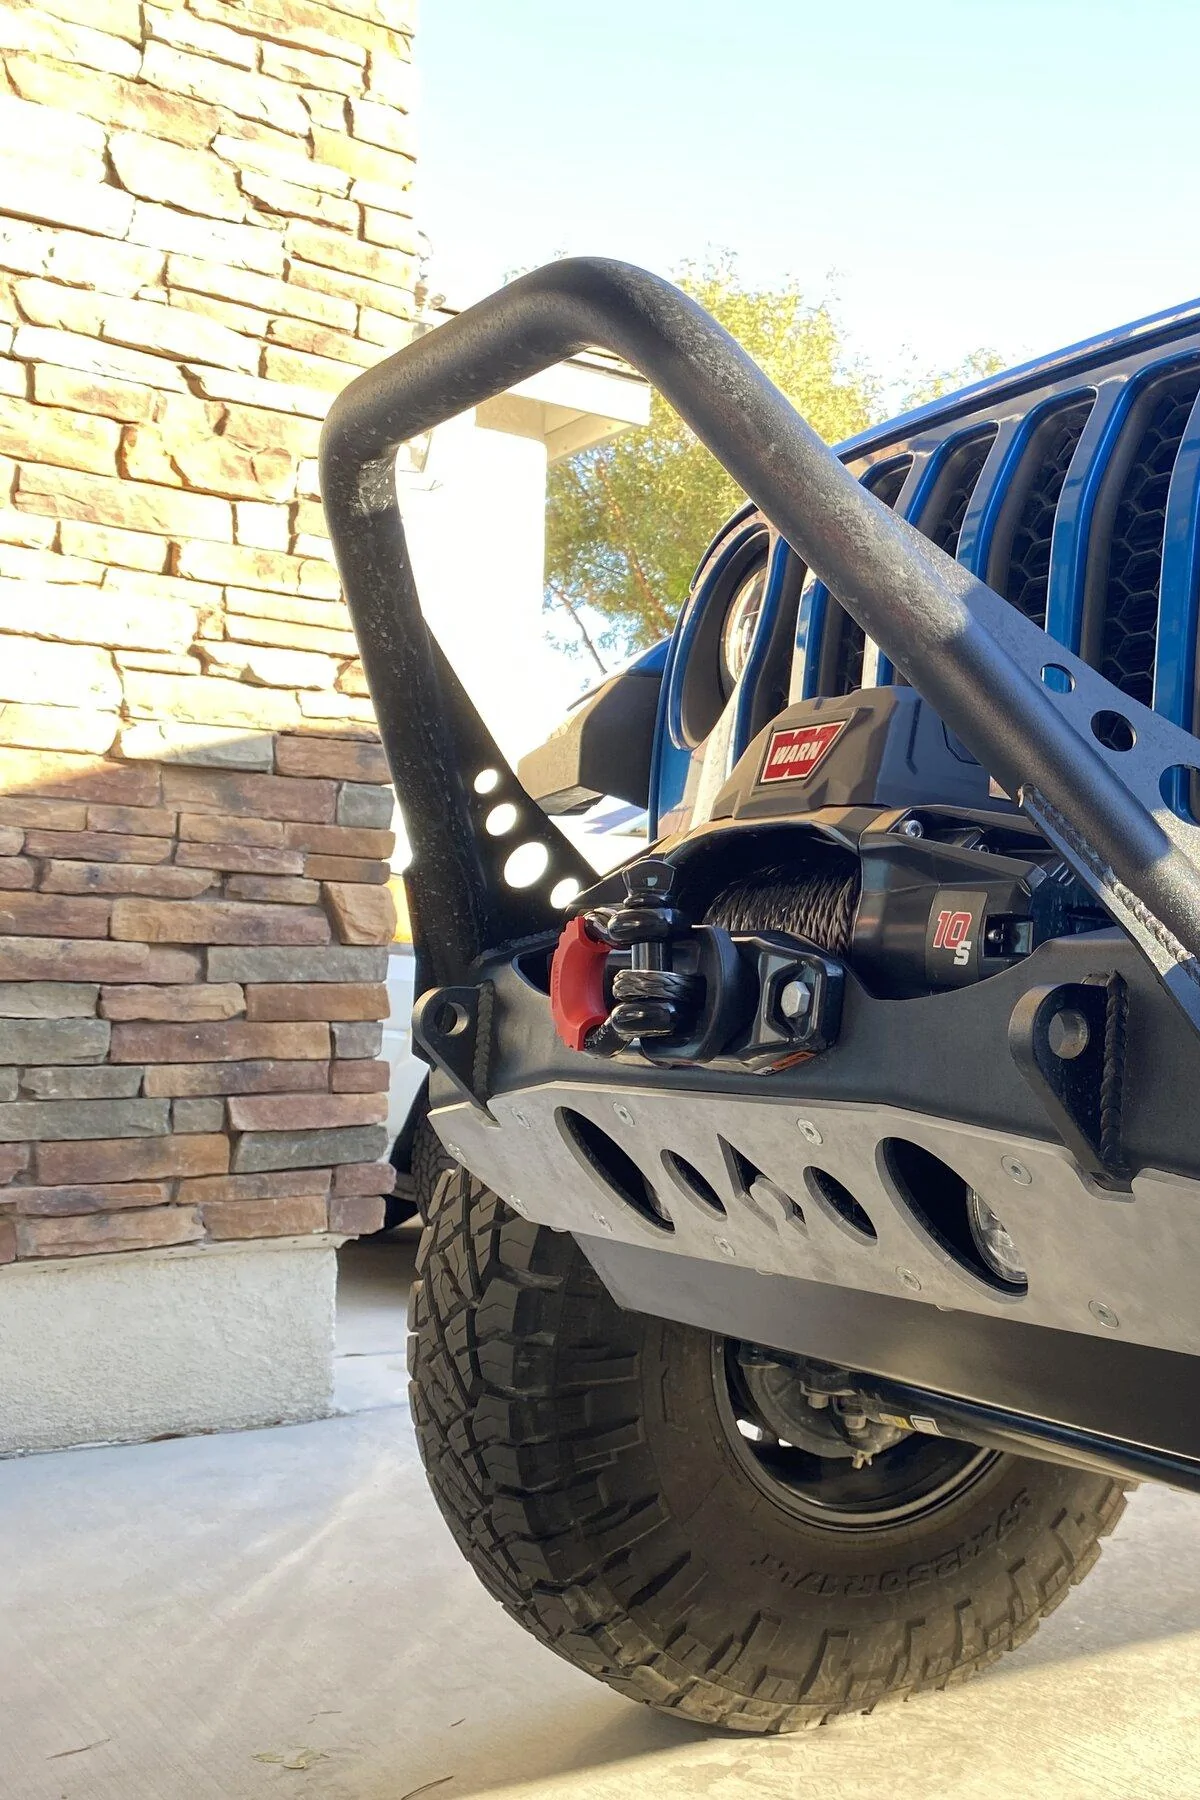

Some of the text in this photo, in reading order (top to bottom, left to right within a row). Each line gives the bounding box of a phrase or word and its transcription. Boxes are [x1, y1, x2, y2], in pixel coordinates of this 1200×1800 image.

[770, 740, 824, 766] WARN
[932, 910, 973, 950] 10
[953, 940, 972, 966] S
